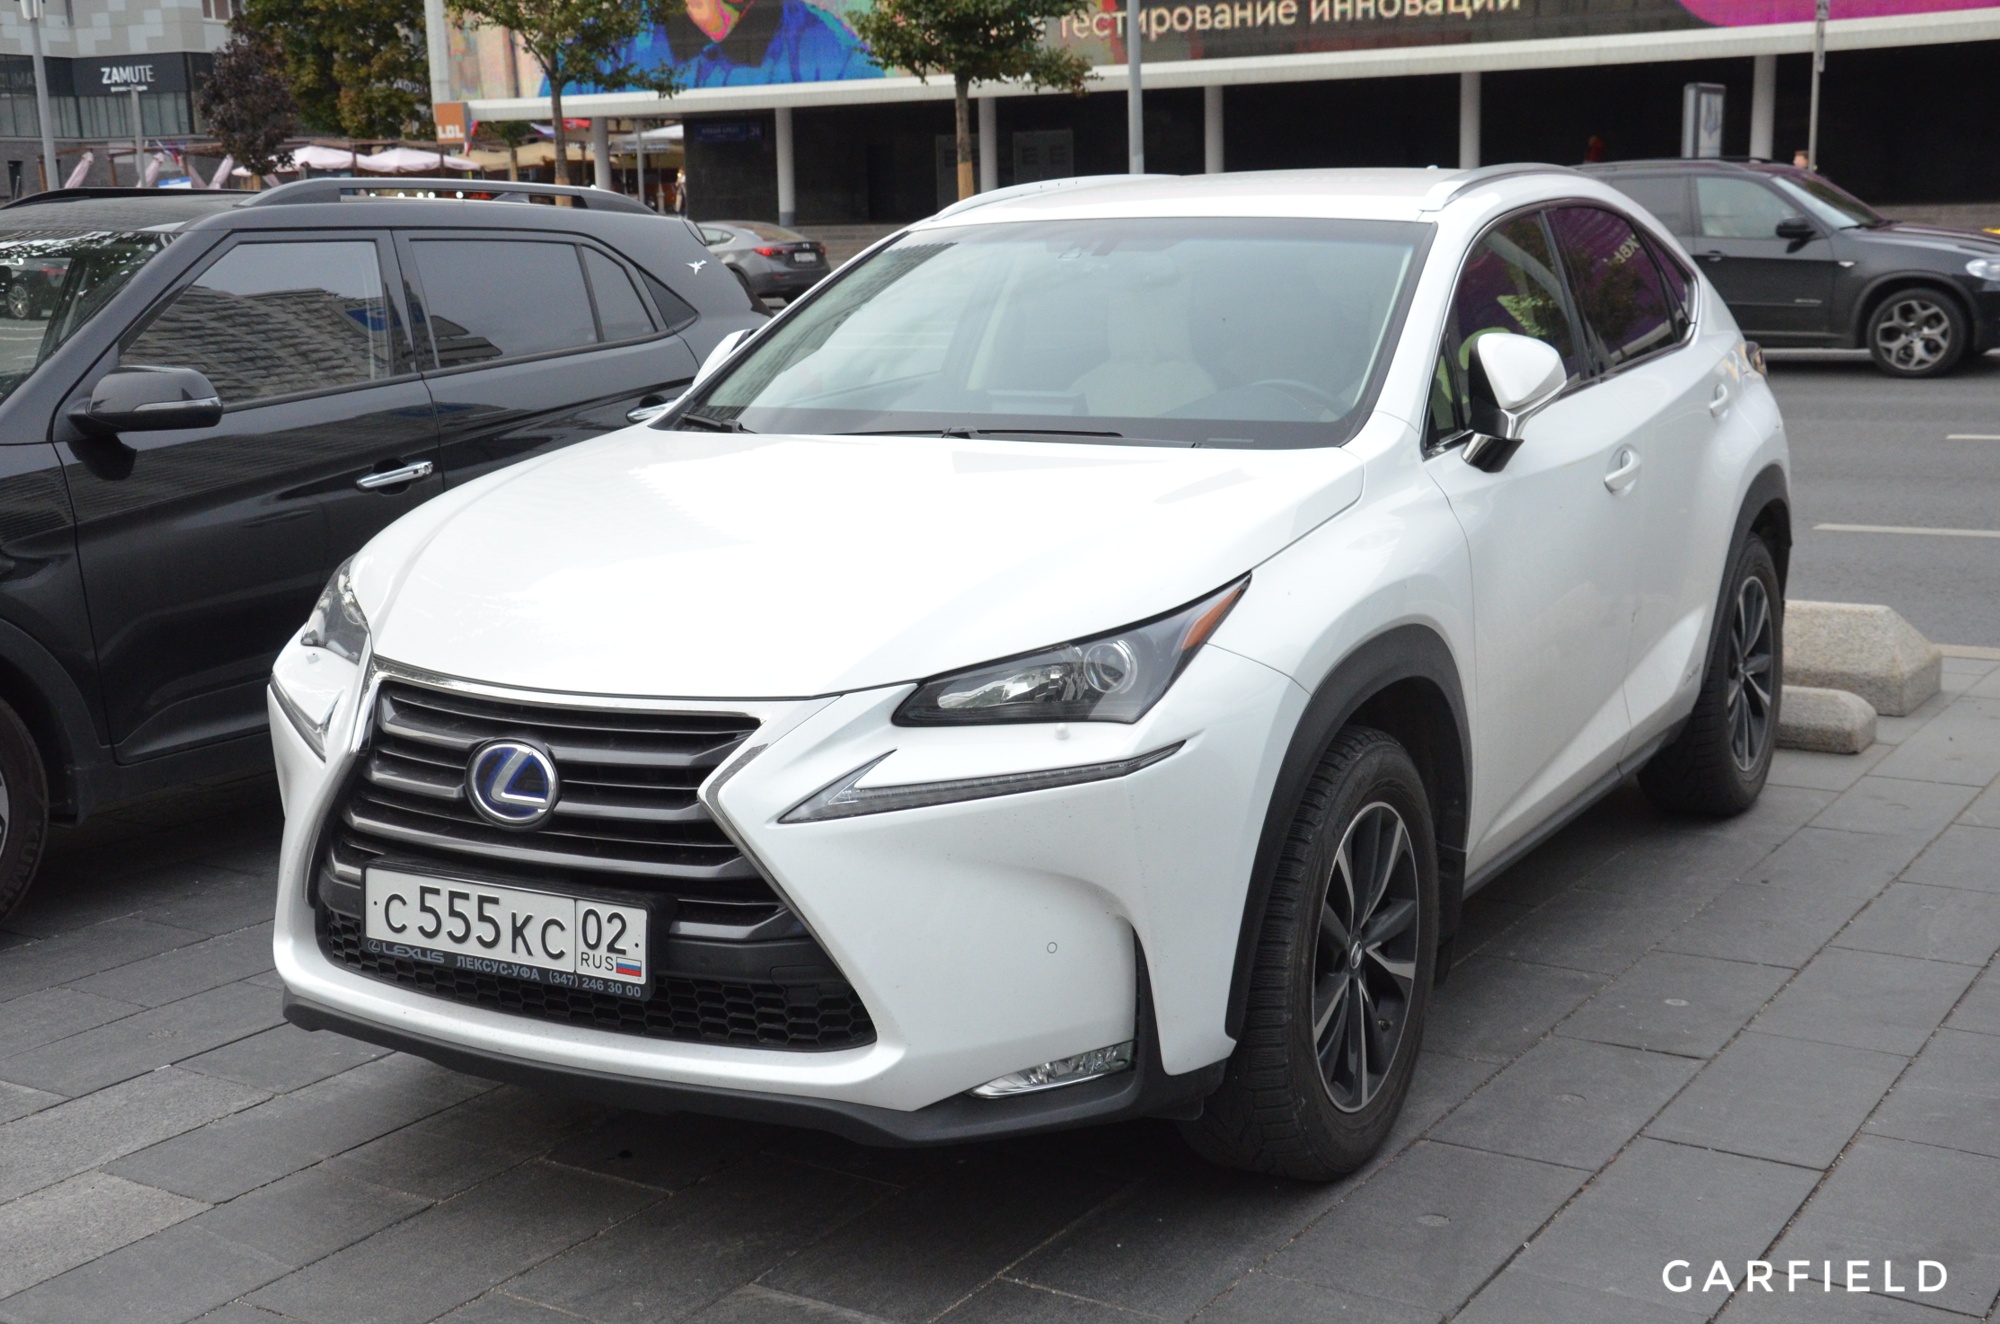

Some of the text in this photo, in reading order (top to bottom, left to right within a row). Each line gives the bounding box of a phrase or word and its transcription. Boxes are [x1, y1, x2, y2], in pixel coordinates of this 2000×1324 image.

[100, 65, 155, 84] ZAMUTE
[581, 908, 627, 956] 02
[383, 942, 641, 998] LEXUS ЛЕКСУС-УФА (347) 246 30 00
[580, 951, 614, 971] RUS
